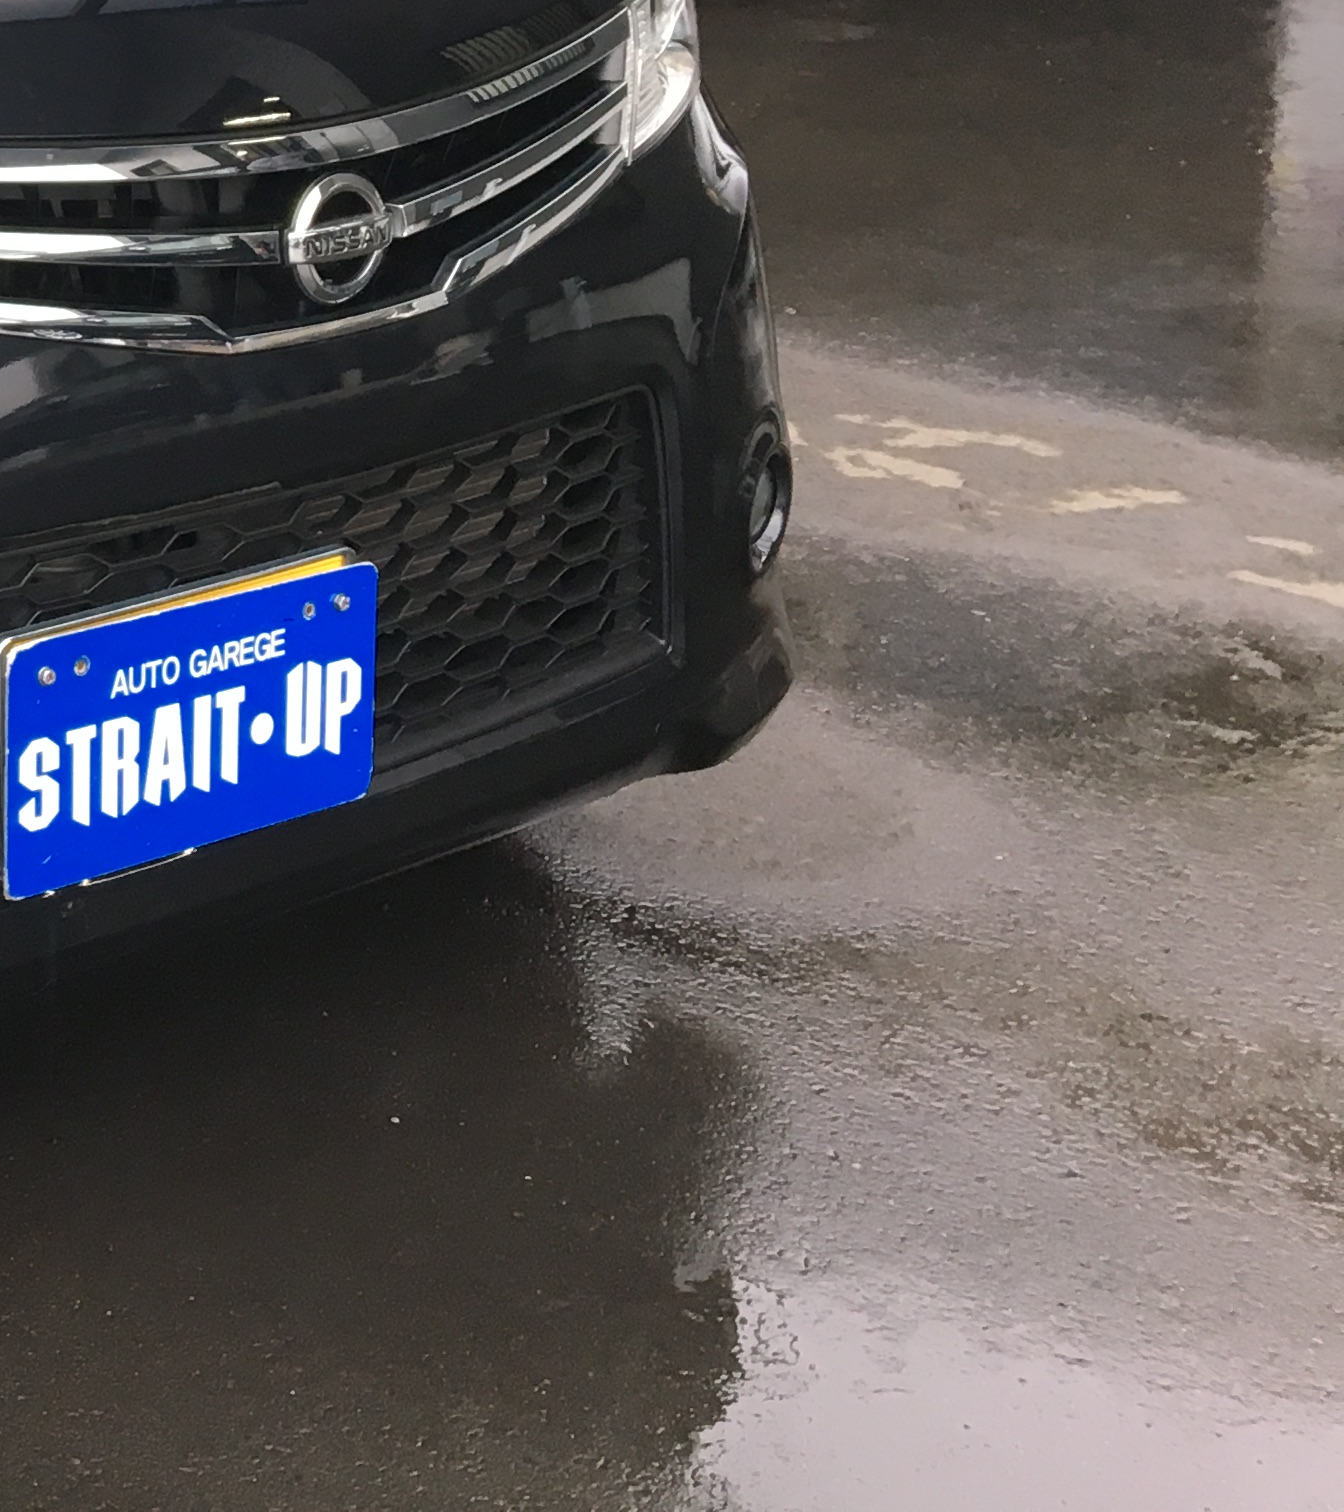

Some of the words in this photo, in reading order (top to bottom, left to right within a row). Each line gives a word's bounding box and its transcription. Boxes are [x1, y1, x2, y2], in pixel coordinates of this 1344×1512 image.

[303, 218, 391, 259] NISSAN
[110, 655, 181, 700] AUTO
[189, 628, 286, 678] GAREGE
